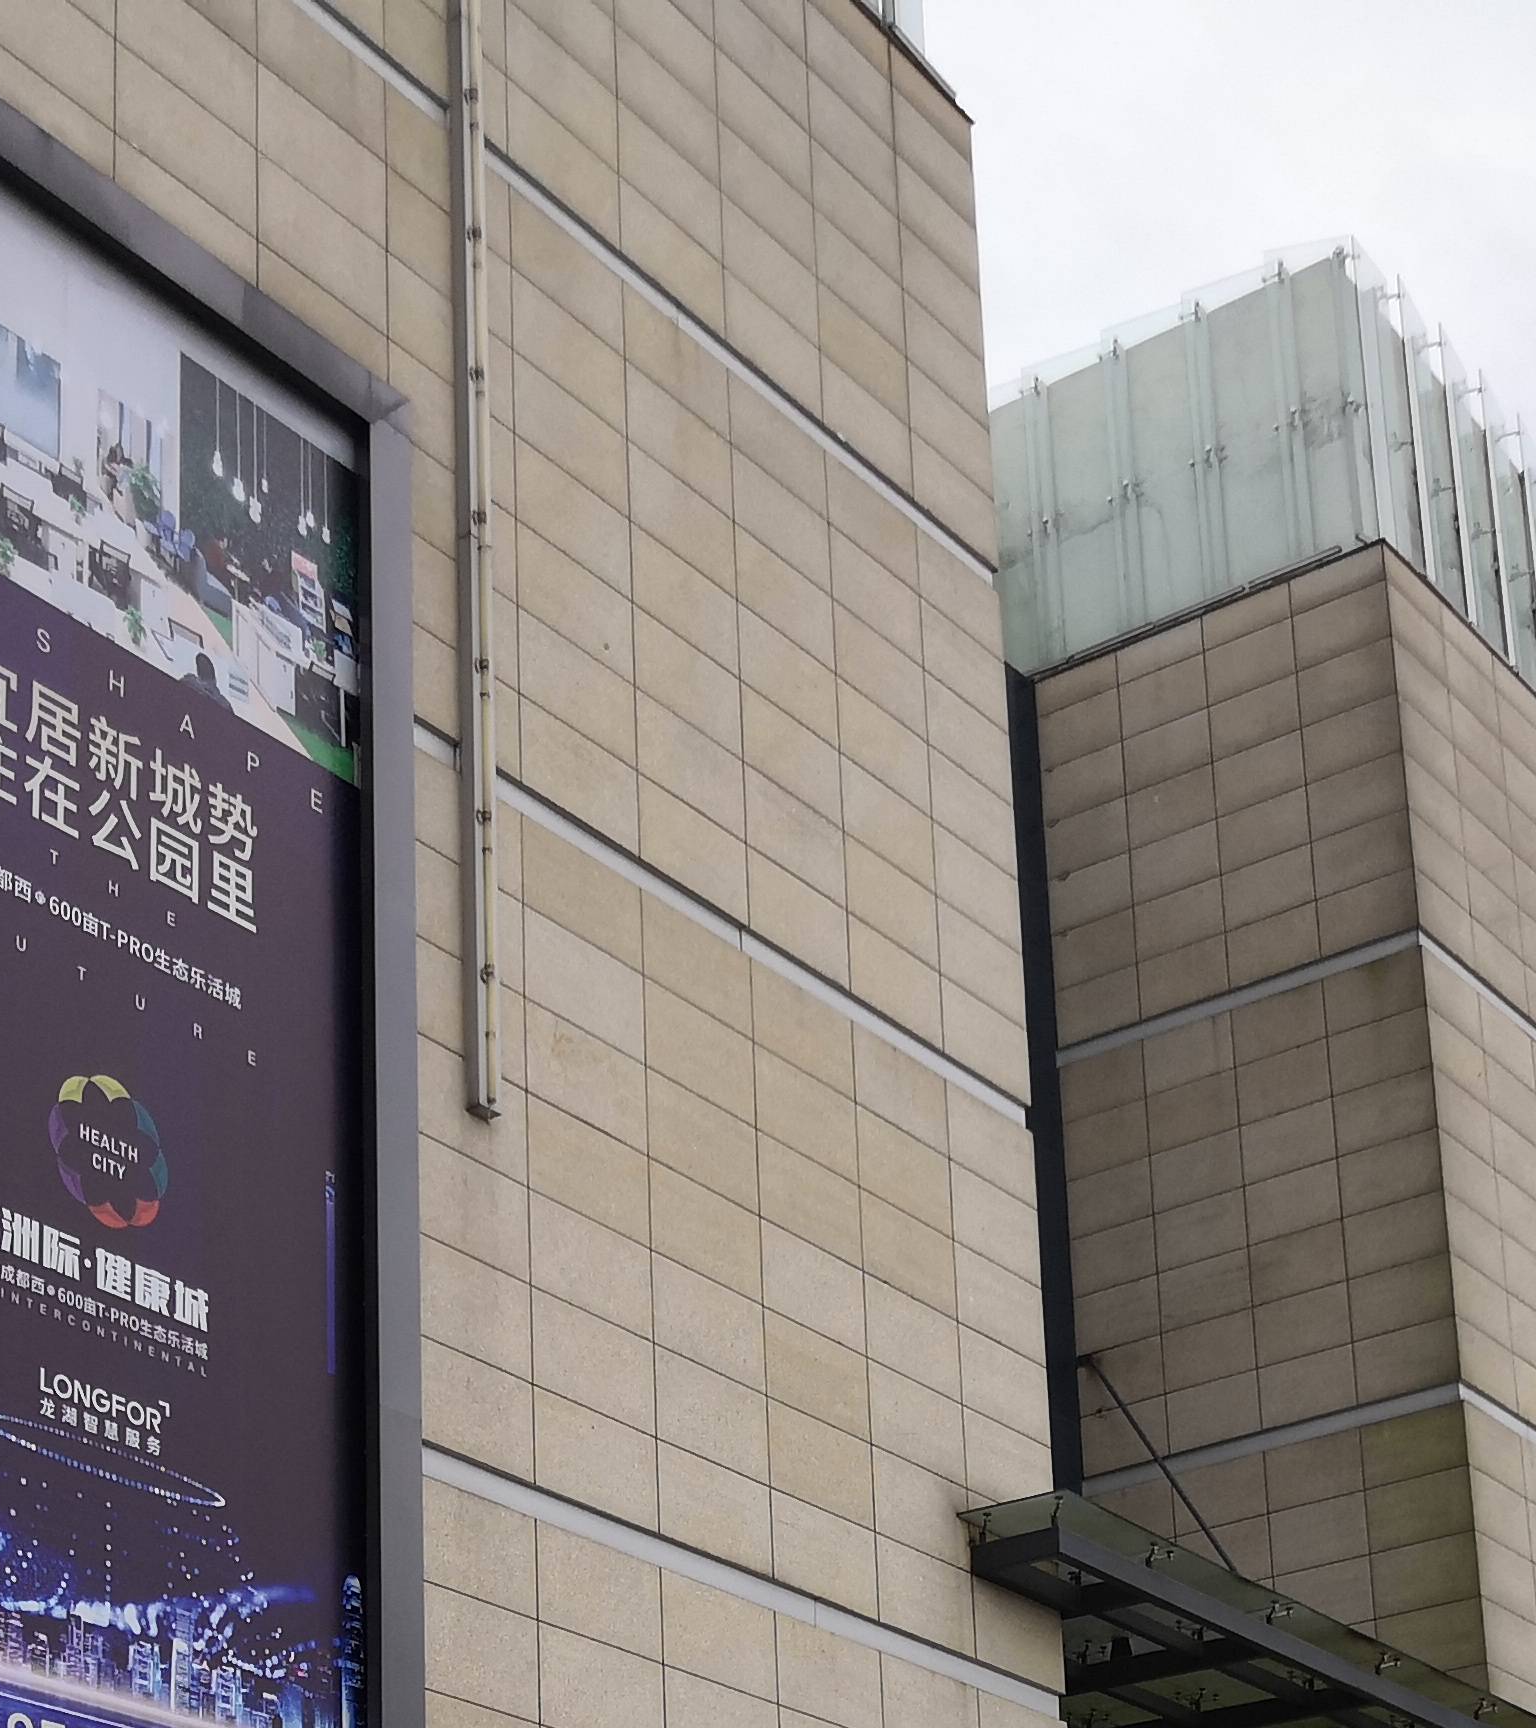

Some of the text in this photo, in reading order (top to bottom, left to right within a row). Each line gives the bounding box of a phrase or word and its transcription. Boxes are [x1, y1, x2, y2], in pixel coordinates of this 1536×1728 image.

[79, 1123, 139, 1164] HEALTH
[92, 1151, 126, 1182] CITY
[0, 1286, 208, 1378] INTERCONTINENTAL
[39, 1366, 162, 1434] LONGFOR
[39, 1397, 162, 1457] 龙湖智慧服务
